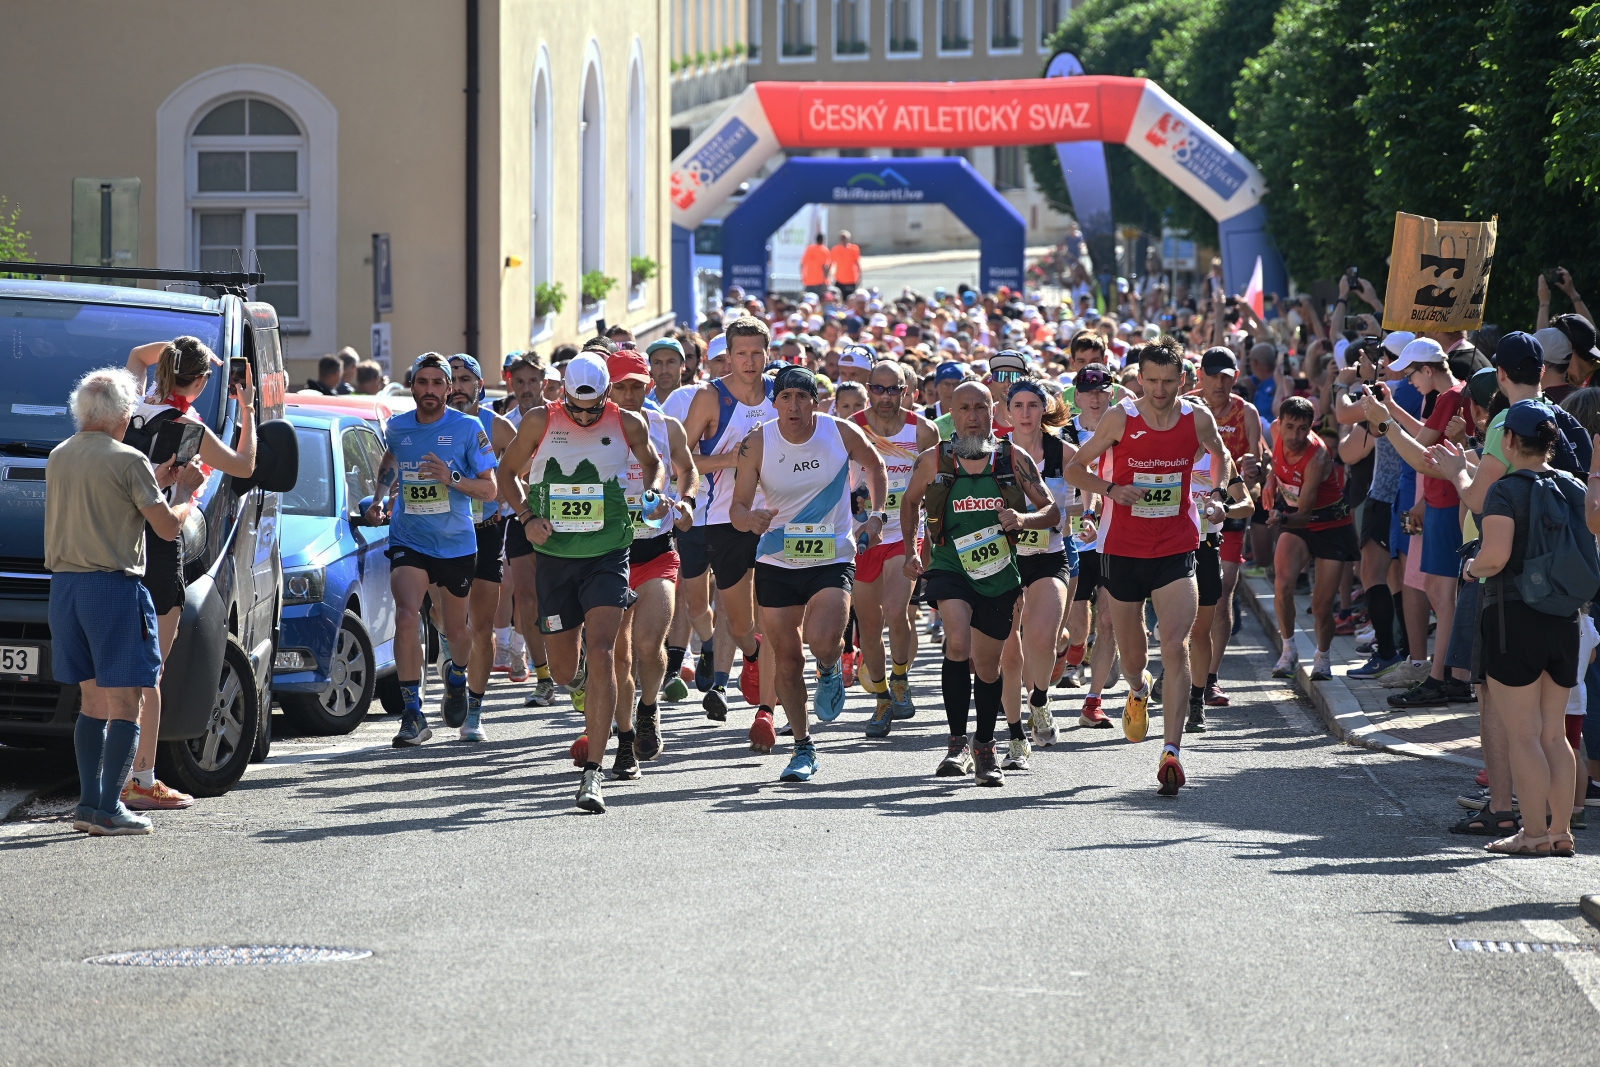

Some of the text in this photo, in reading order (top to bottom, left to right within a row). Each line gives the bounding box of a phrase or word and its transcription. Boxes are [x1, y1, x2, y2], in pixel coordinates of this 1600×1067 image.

[809, 99, 1092, 133] ČESKÝ ATLETICKÝ SVAZ
[792, 459, 820, 473] ARG
[410, 485, 437, 499] 834
[1143, 488, 1171, 502] 642
[561, 501, 592, 516] 239
[953, 495, 1004, 513] MÉXICO
[795, 540, 823, 554] 472
[971, 542, 999, 563] 498
